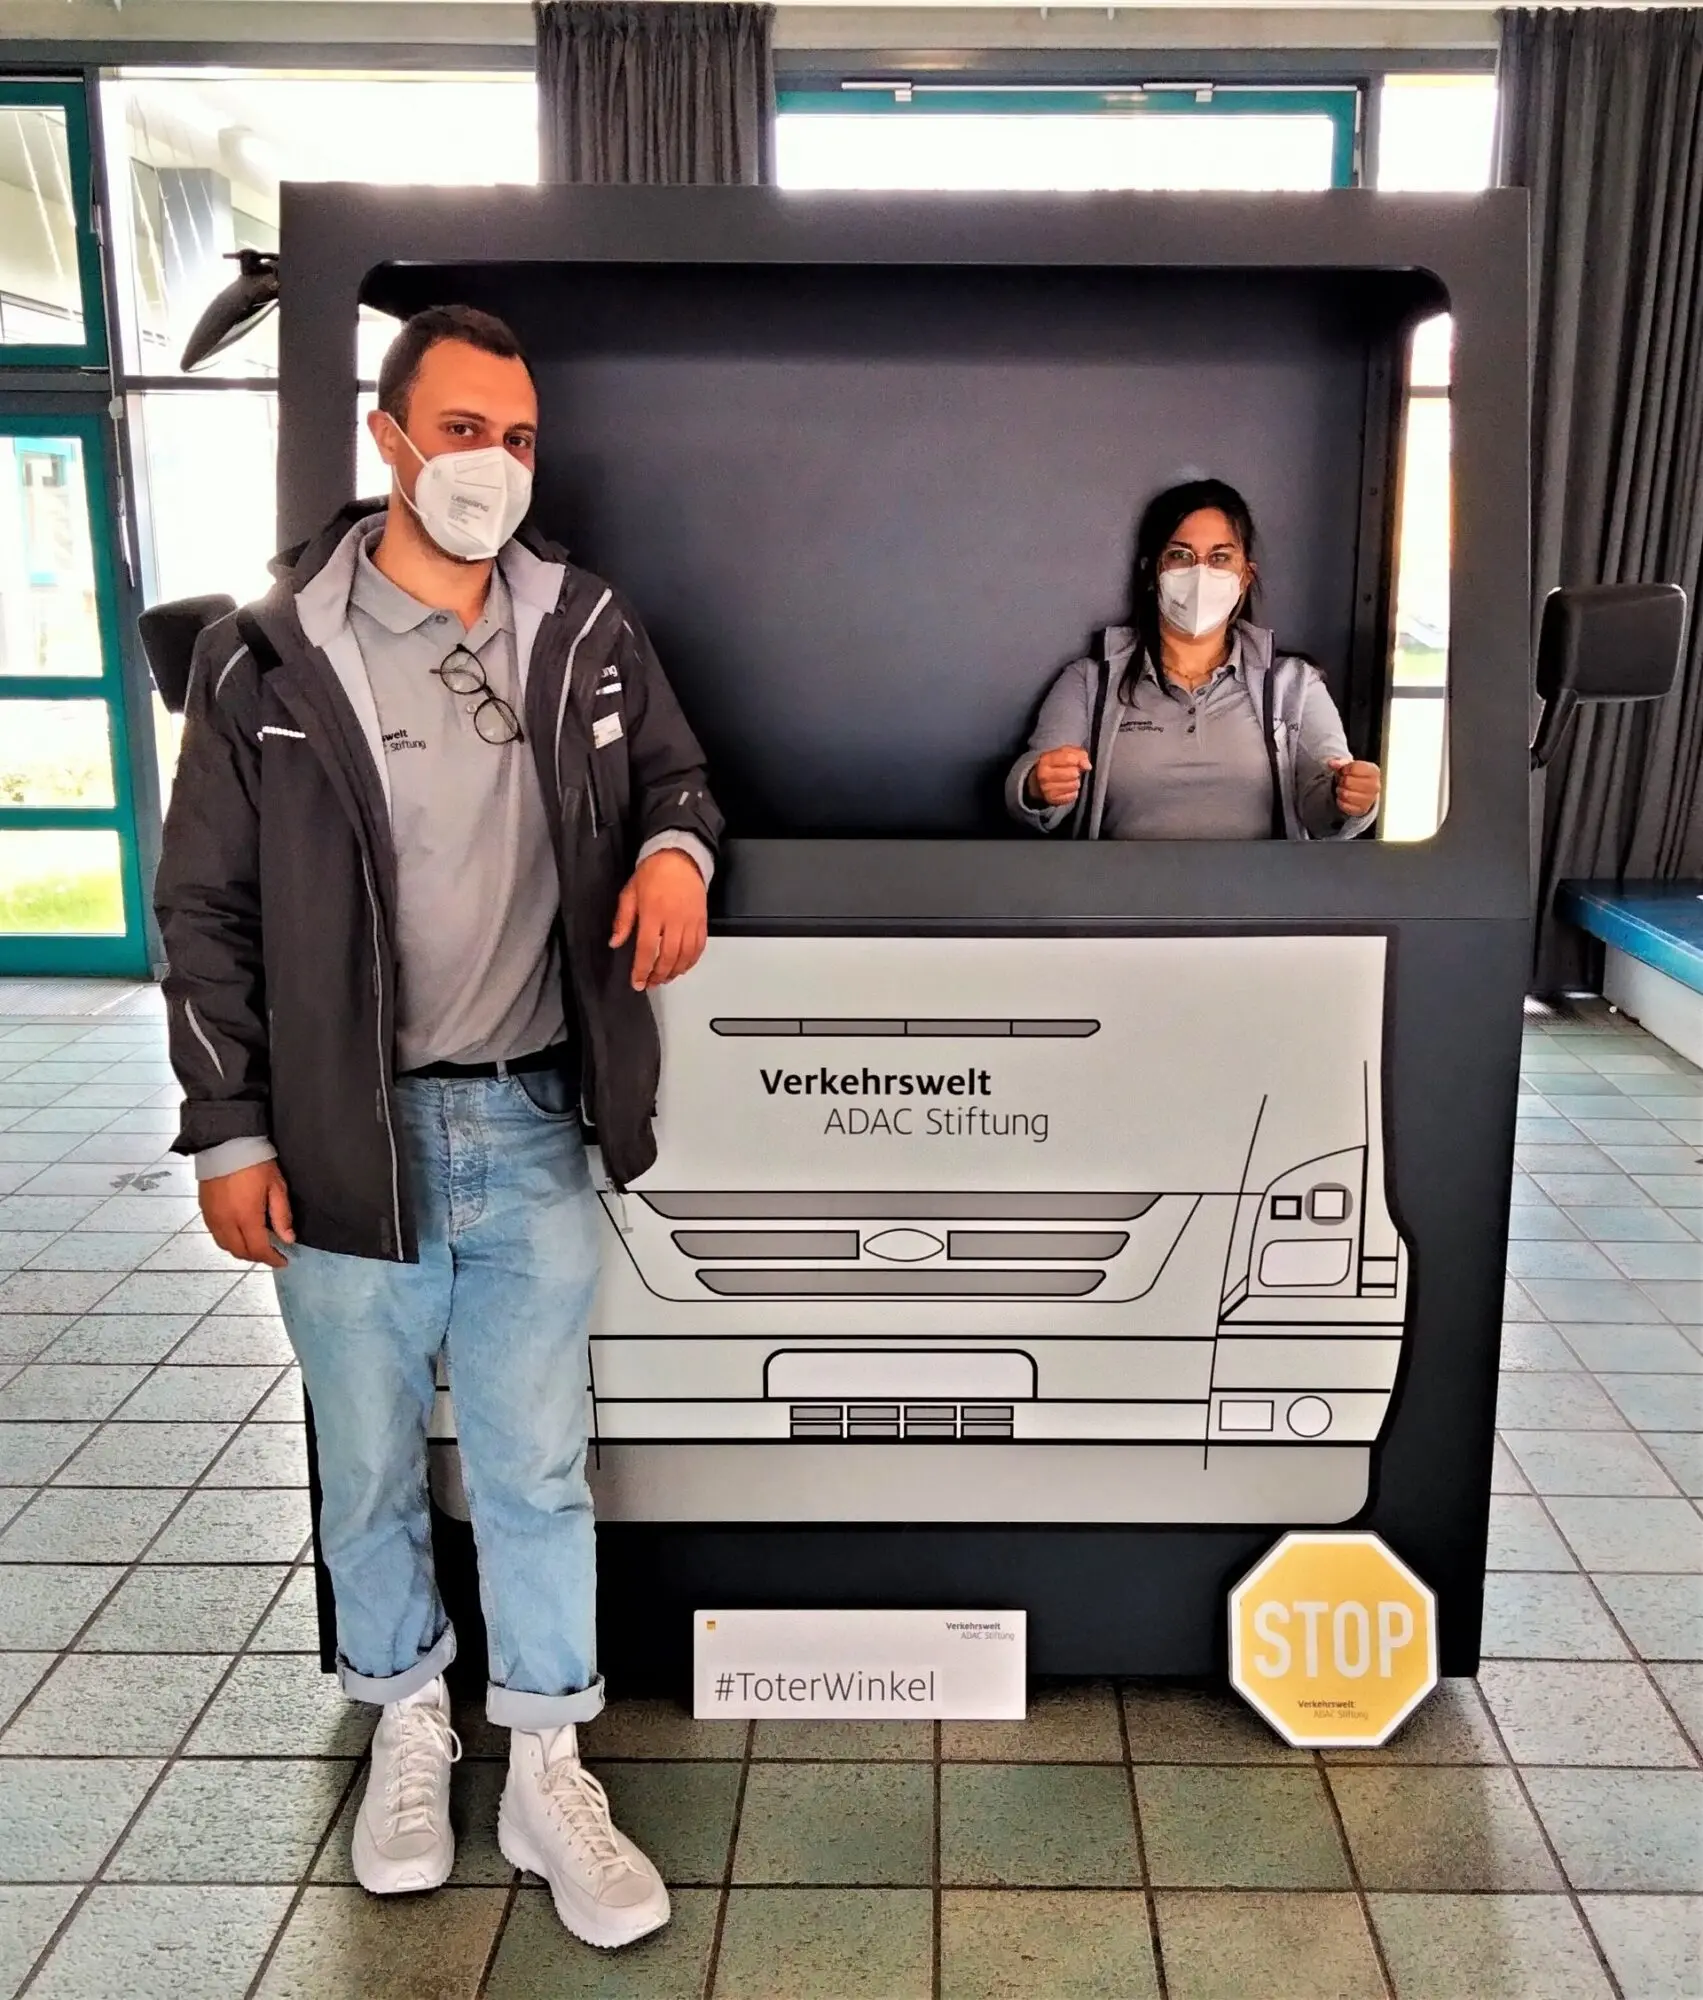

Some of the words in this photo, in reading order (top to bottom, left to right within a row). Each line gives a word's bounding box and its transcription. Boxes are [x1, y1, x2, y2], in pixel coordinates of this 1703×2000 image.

[390, 739, 427, 752] Stiftung
[759, 1067, 992, 1096] Verkehrswelt
[824, 1107, 913, 1136] ADAC
[926, 1105, 1049, 1143] Stiftung
[945, 1621, 1001, 1630] Verkehrswelt
[1253, 1600, 1414, 1679] STOP
[714, 1671, 935, 1702] #ToterWinkel
[1297, 1700, 1355, 1709] Verkehrswelt
